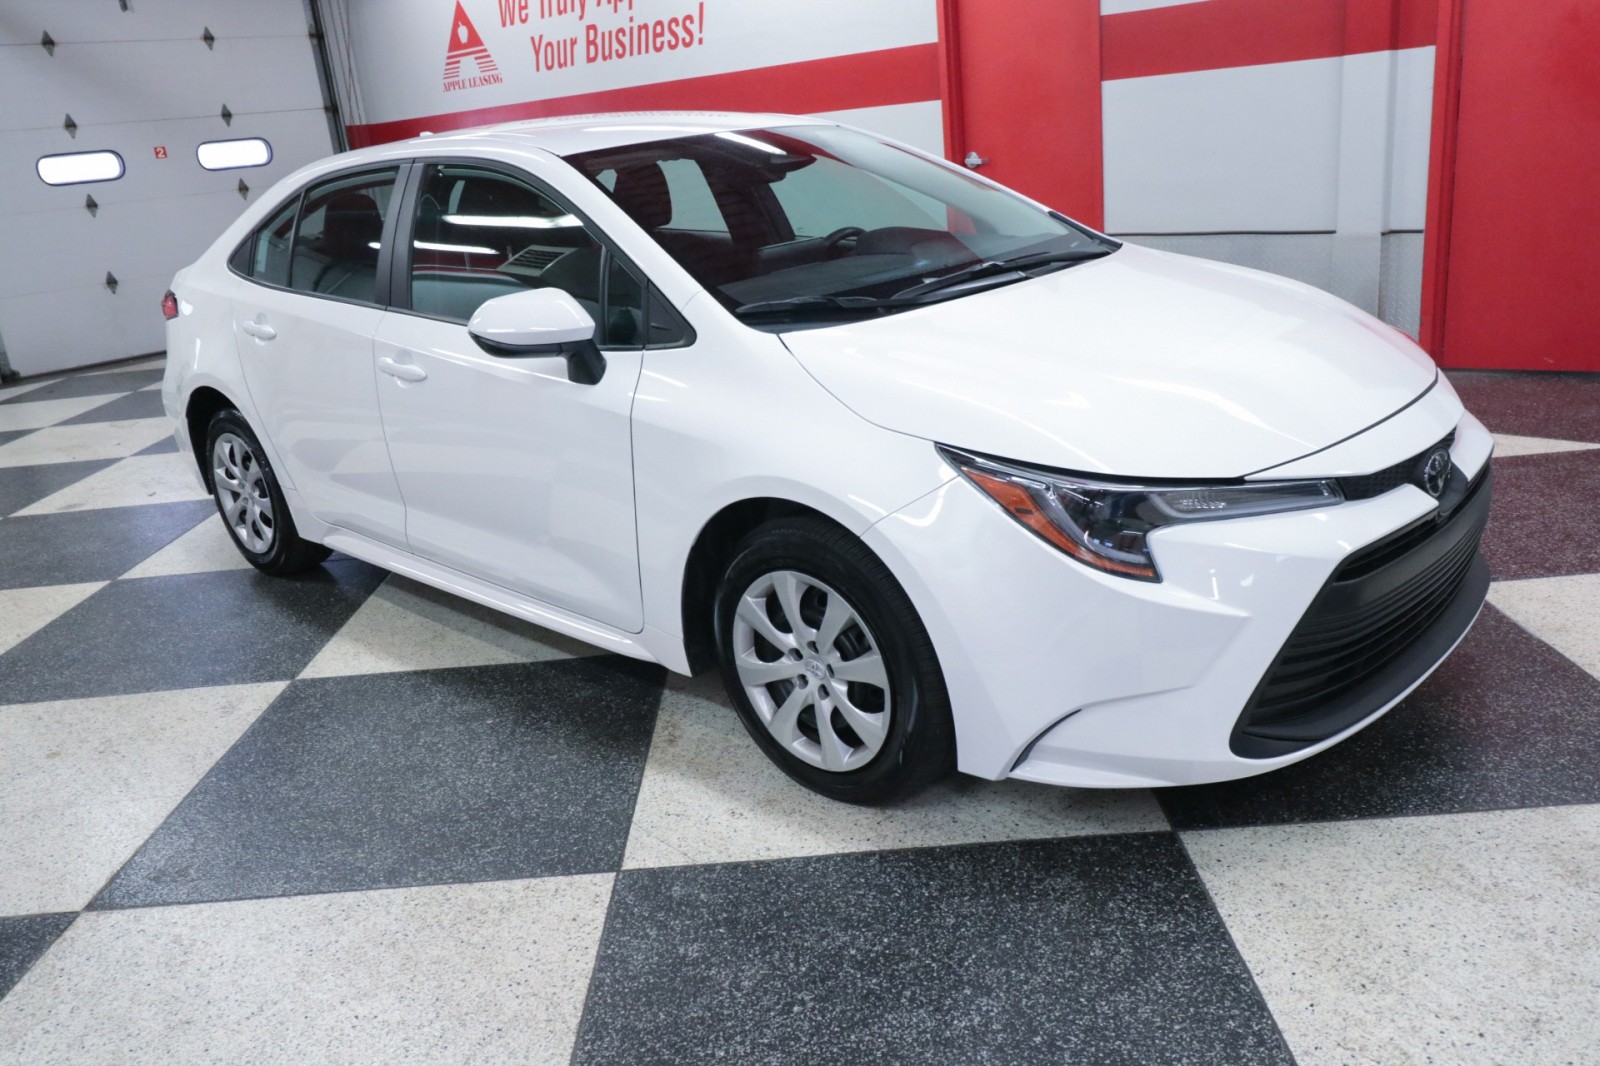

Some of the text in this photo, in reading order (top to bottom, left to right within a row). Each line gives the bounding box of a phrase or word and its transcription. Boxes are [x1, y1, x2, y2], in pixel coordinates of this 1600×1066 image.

[498, 0, 529, 28] We
[530, 2, 705, 72] Your Business!
[443, 72, 503, 93] APPLE LEASING
[156, 147, 166, 158] 2
